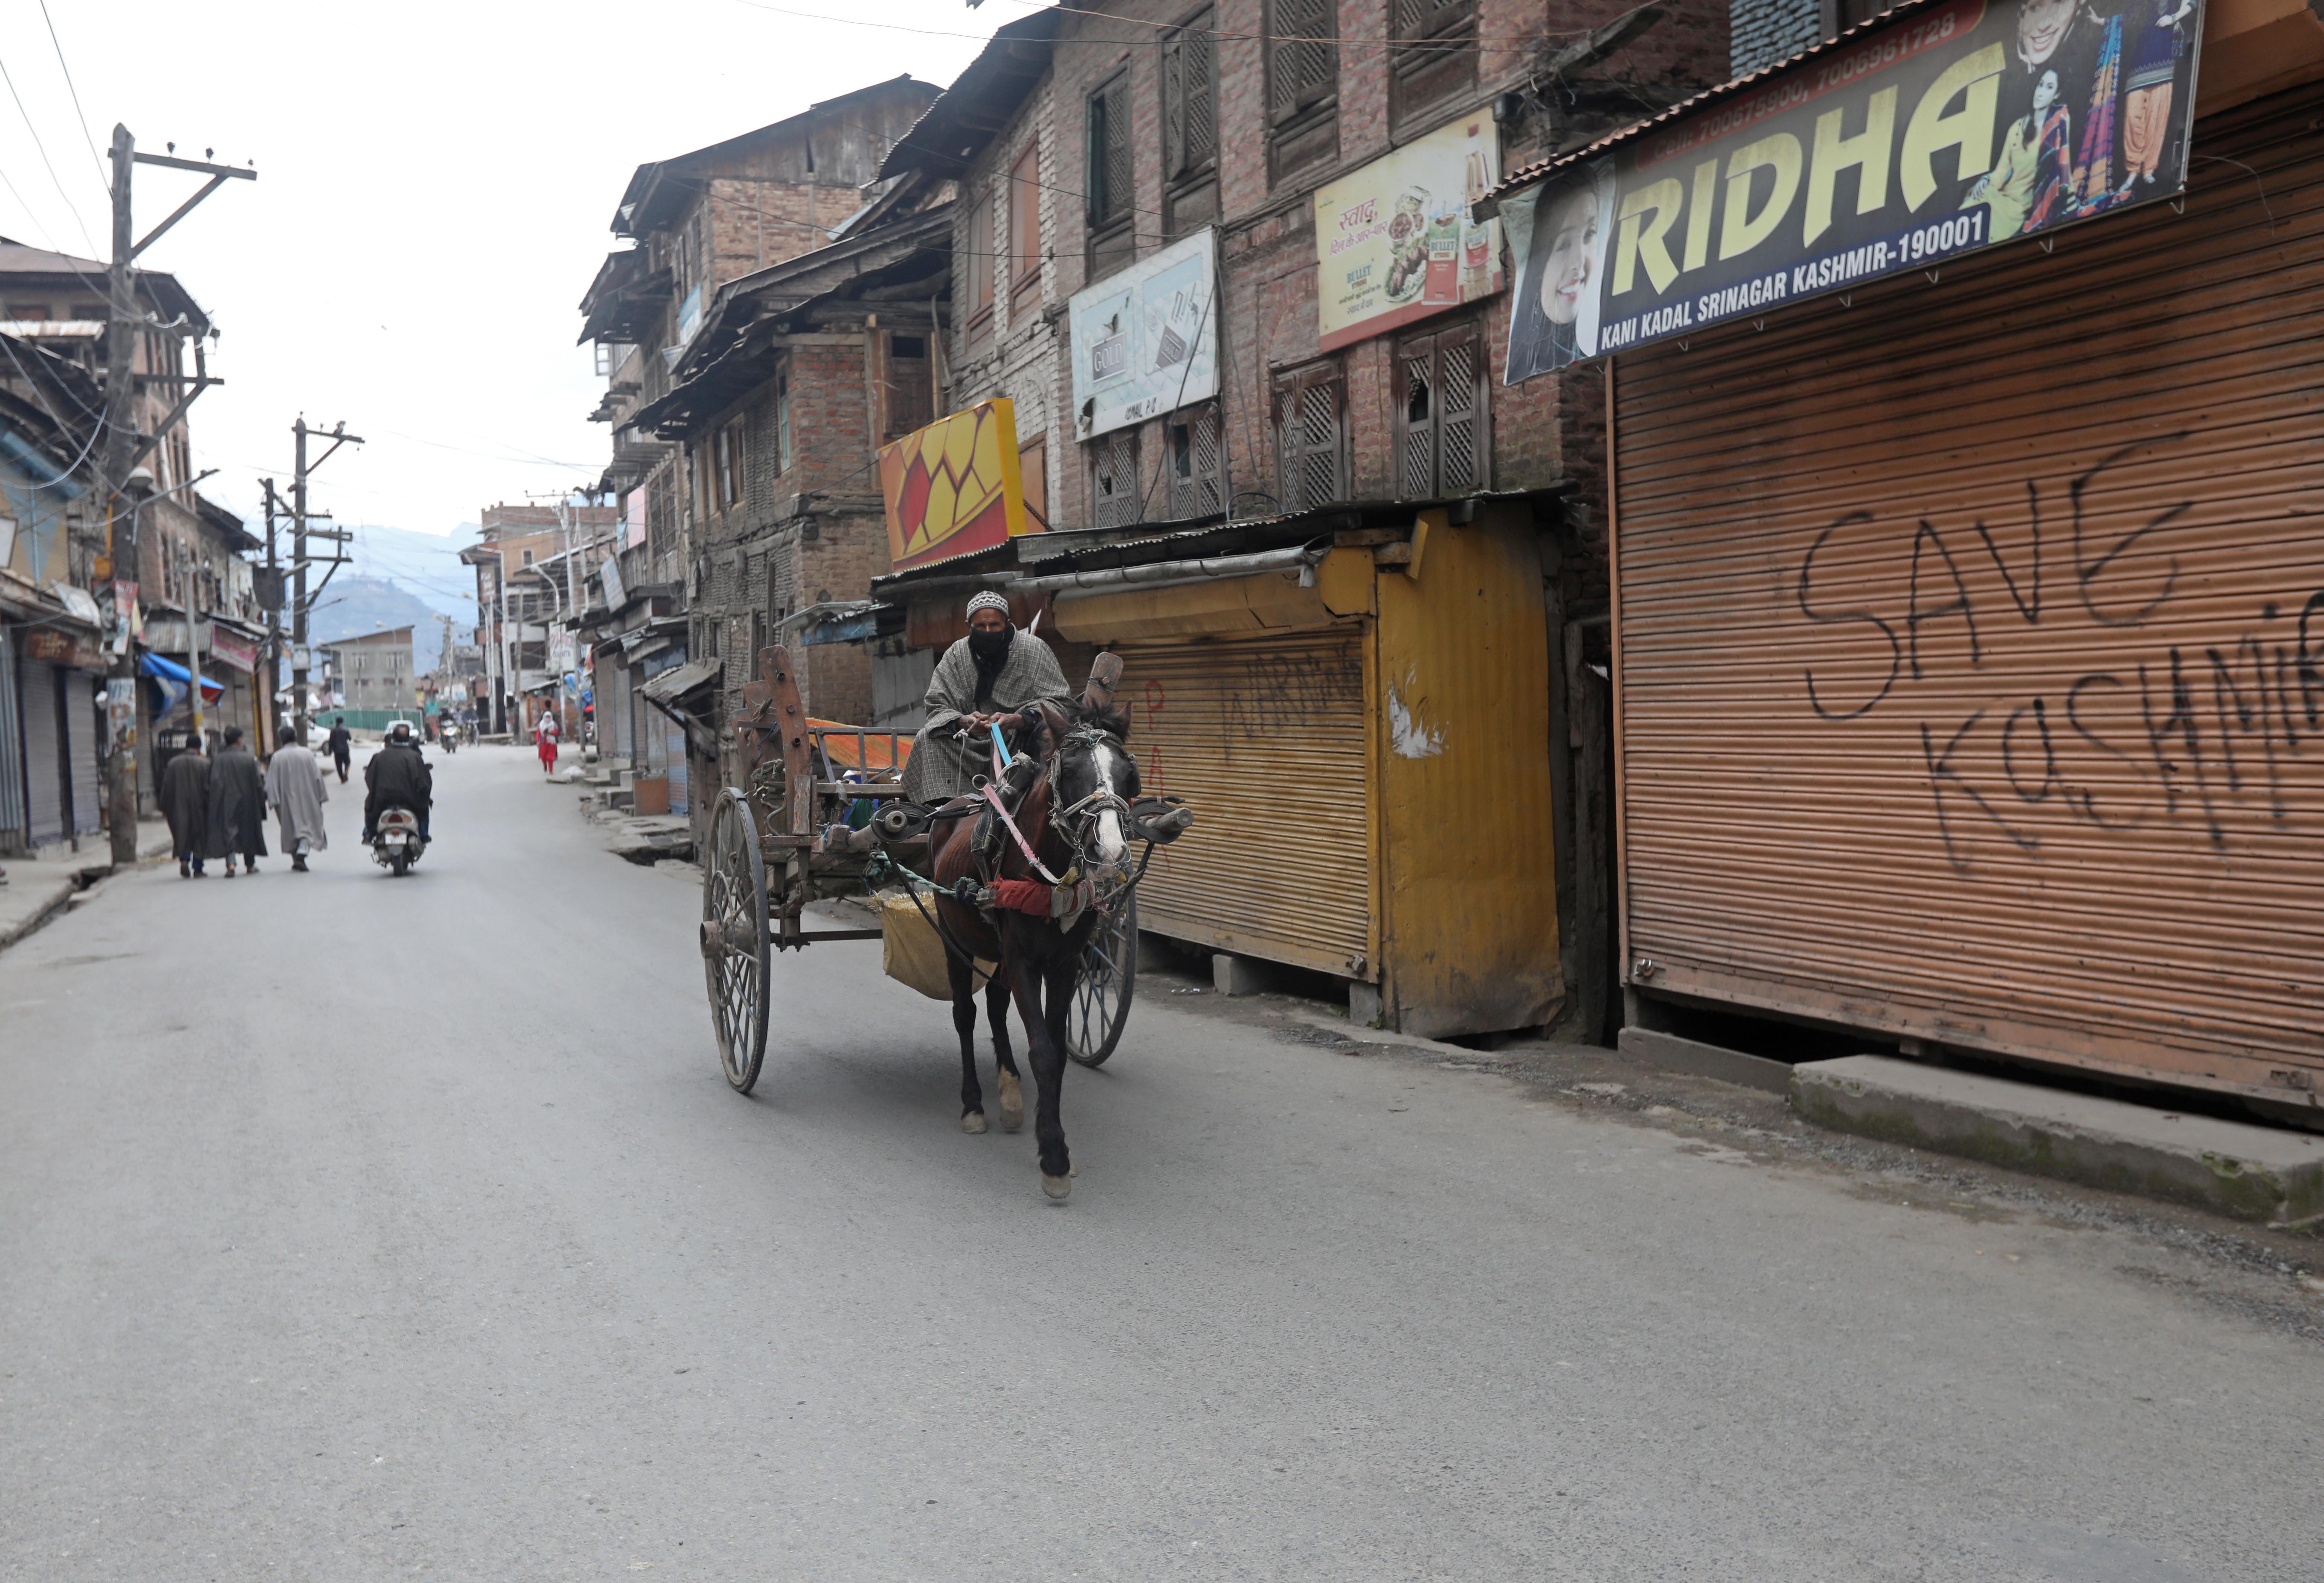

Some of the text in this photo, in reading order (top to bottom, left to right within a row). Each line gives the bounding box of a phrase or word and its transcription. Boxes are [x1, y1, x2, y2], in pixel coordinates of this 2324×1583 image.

[1653, 134, 1693, 160] Cell:
[1818, 12, 1955, 90] 7006961728
[1611, 42, 2006, 296] RIDHA
[1431, 241, 1455, 251] BULLET
[1601, 212, 1984, 350] KANI KADAL SRINAGAR KASHMIR-190001
[1095, 343, 1122, 372] GOLD
[1164, 341, 1179, 360] GOLD
[1799, 431, 2195, 721] SAVE
